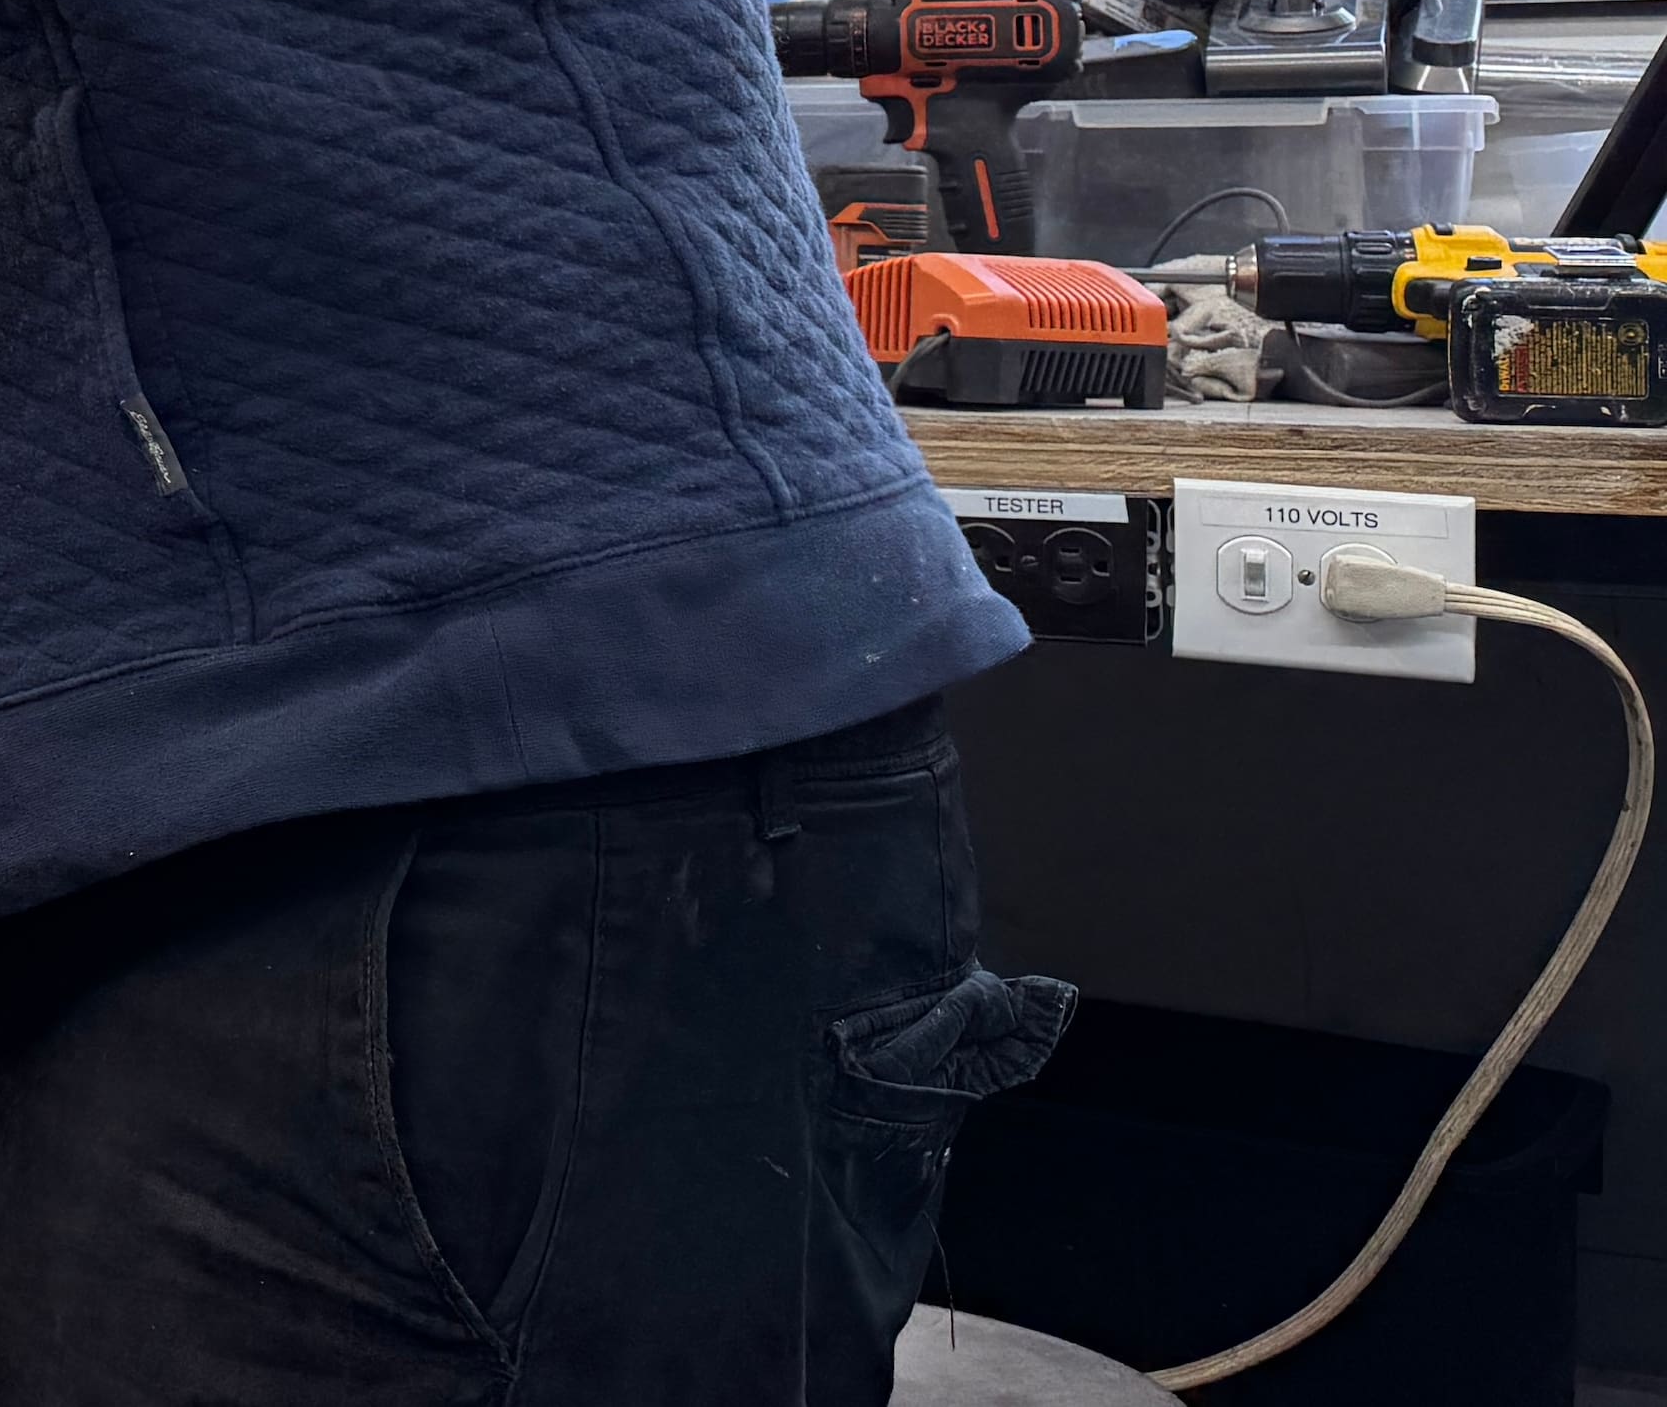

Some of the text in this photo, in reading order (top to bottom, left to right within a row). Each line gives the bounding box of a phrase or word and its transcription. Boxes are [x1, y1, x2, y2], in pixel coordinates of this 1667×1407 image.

[922, 34, 989, 46] DECKER
[984, 497, 1064, 515] TESTER
[1265, 507, 1379, 529] 110 VOLTS
